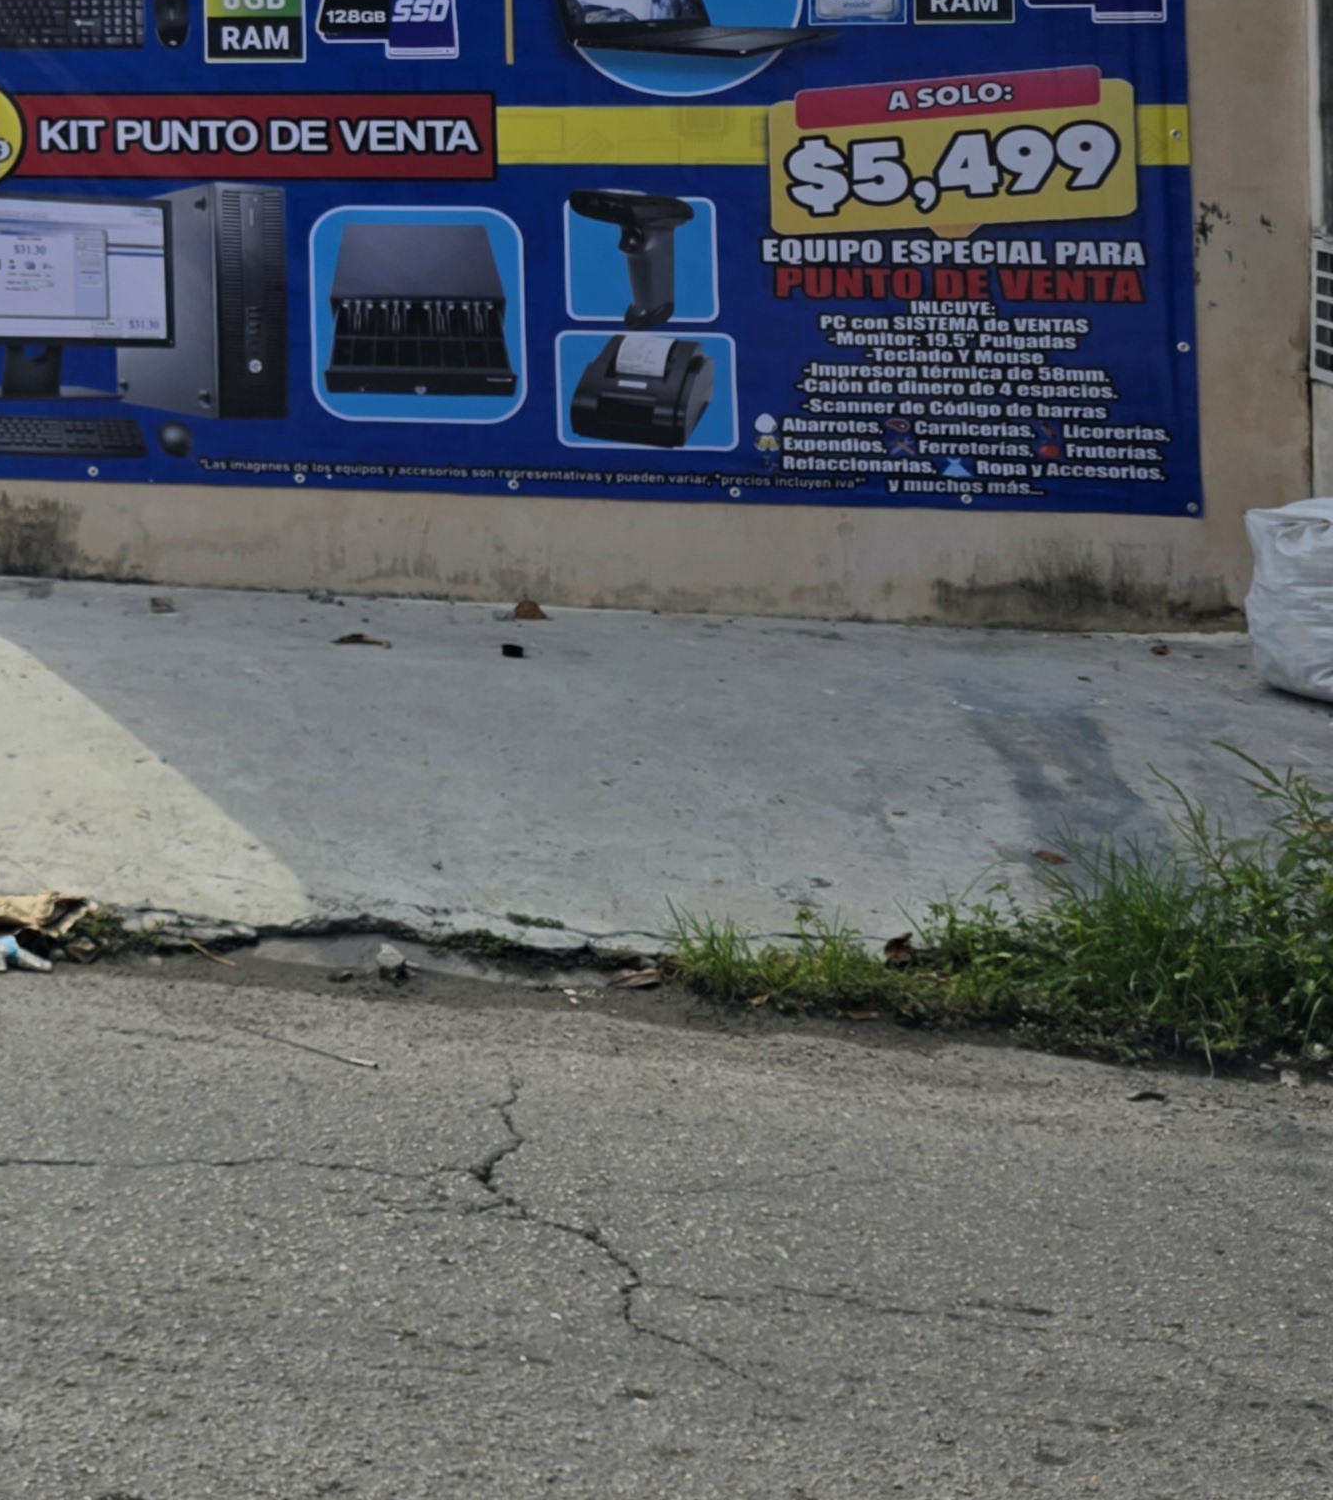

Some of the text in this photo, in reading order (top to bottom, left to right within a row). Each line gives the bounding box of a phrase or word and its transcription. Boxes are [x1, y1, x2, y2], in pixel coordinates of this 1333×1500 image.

[326, 10, 386, 23] 128GB
[221, 25, 289, 50] RAM
[888, 82, 1013, 111] A SOLO:
[39, 119, 479, 153] KIT PUNTO DE VENTA
[788, 123, 1117, 213] $5,499
[762, 238, 1146, 266] EQUIPO ESPECIAL PARA
[775, 267, 1145, 302] PUNTO DE VENTA
[910, 300, 996, 317] INLCUYE:
[820, 315, 1089, 334] PC con SISTEMA VENTAS
[979, 334, 1077, 350] Pulgadas
[975, 350, 1044, 365] Mouse
[921, 363, 1003, 381] térmica
[1038, 367, 1110, 383] 58mm.
[897, 380, 965, 396] dinero
[1016, 383, 1118, 400] espacios.
[929, 400, 1002, 418] Código
[1037, 403, 1107, 420] barras
[231, 459, 831, 489] imagenes equipos accesorios representativas pueden incluyen
[976, 460, 1027, 476] Ropa
[903, 479, 983, 493] muchos
